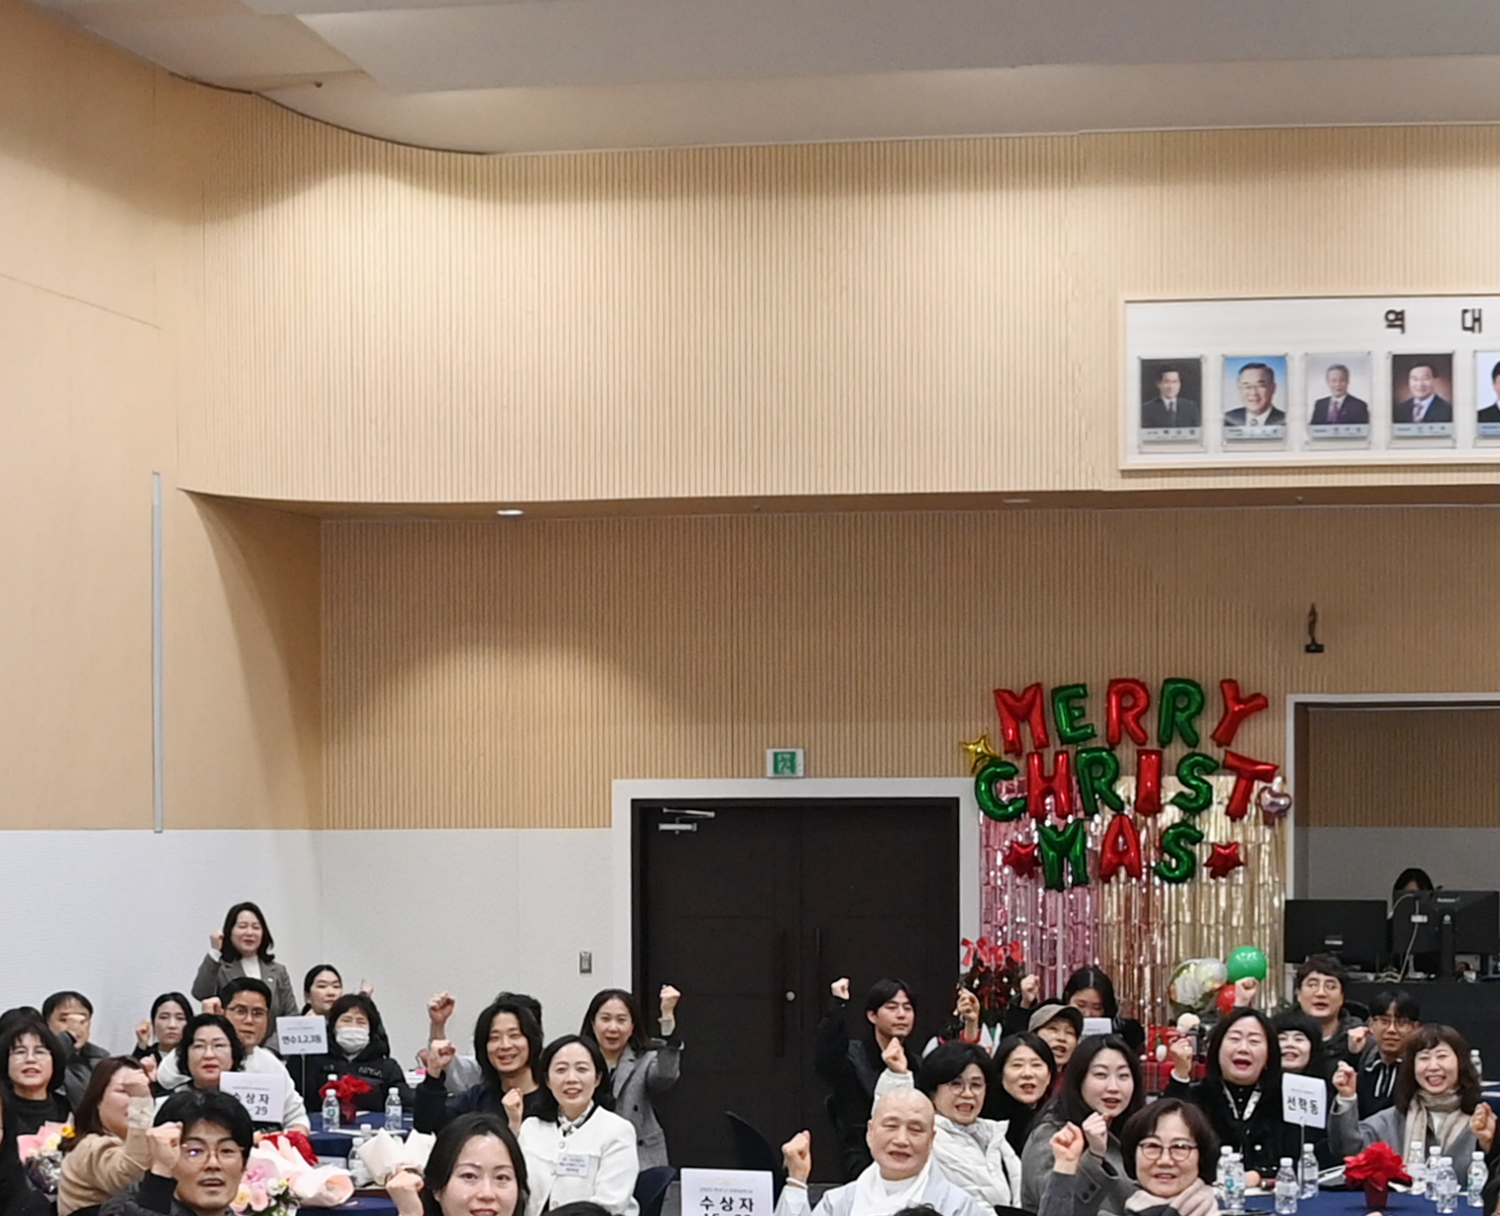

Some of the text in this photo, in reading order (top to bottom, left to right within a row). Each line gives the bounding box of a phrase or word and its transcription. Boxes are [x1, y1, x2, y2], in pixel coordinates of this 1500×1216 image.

[1384, 309, 1405, 334] 역
[1461, 308, 1483, 334] 대
[993, 677, 1269, 756] MERRY
[974, 746, 1279, 822] CHRIST
[1037, 813, 1205, 892] MAS
